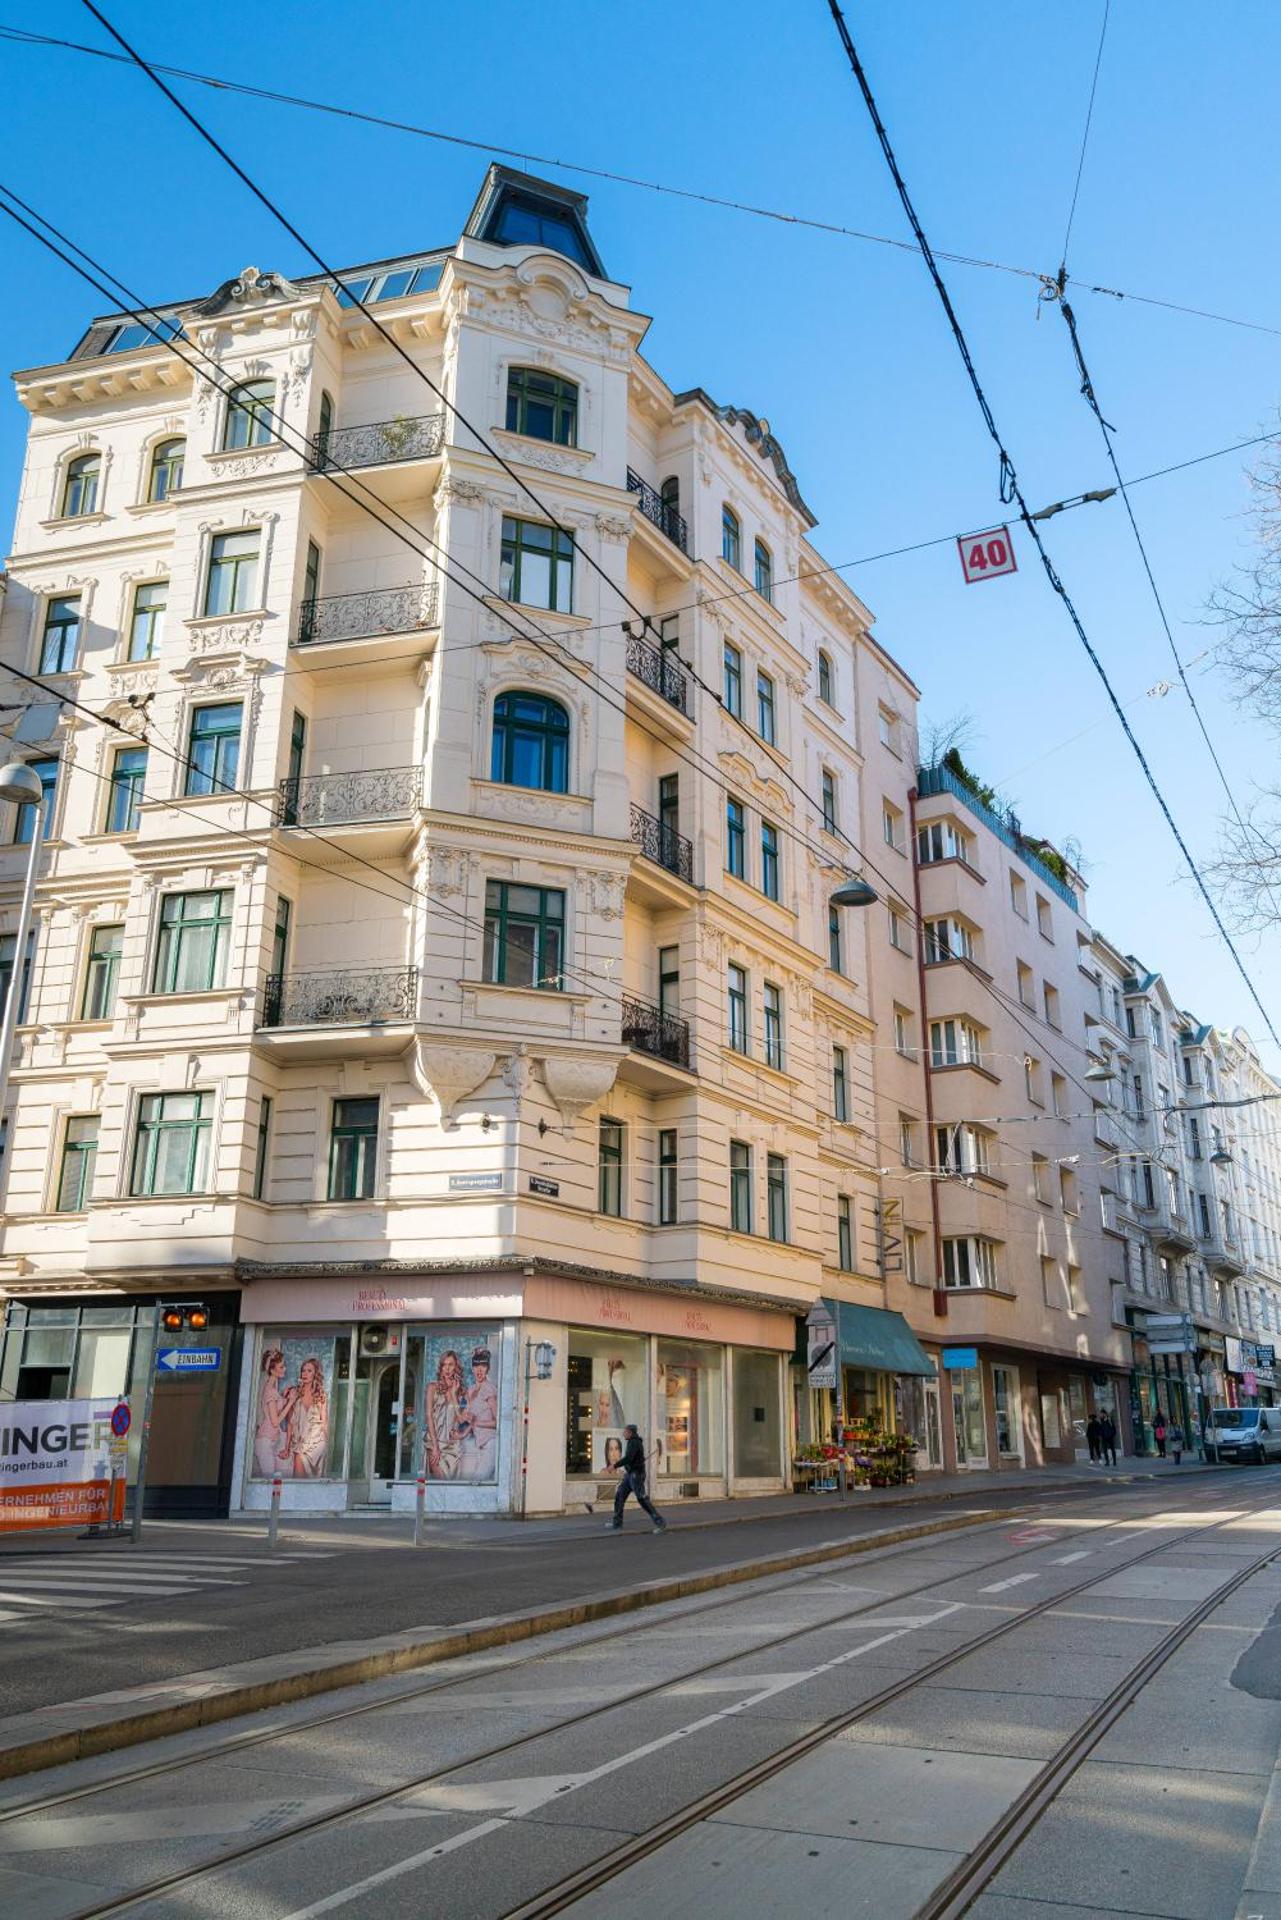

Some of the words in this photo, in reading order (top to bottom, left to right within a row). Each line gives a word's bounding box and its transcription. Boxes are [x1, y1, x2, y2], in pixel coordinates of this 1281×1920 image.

[969, 539, 1008, 570] 40
[176, 1353, 214, 1364] EINBAHN
[78, 1486, 106, 1501] FÜR
